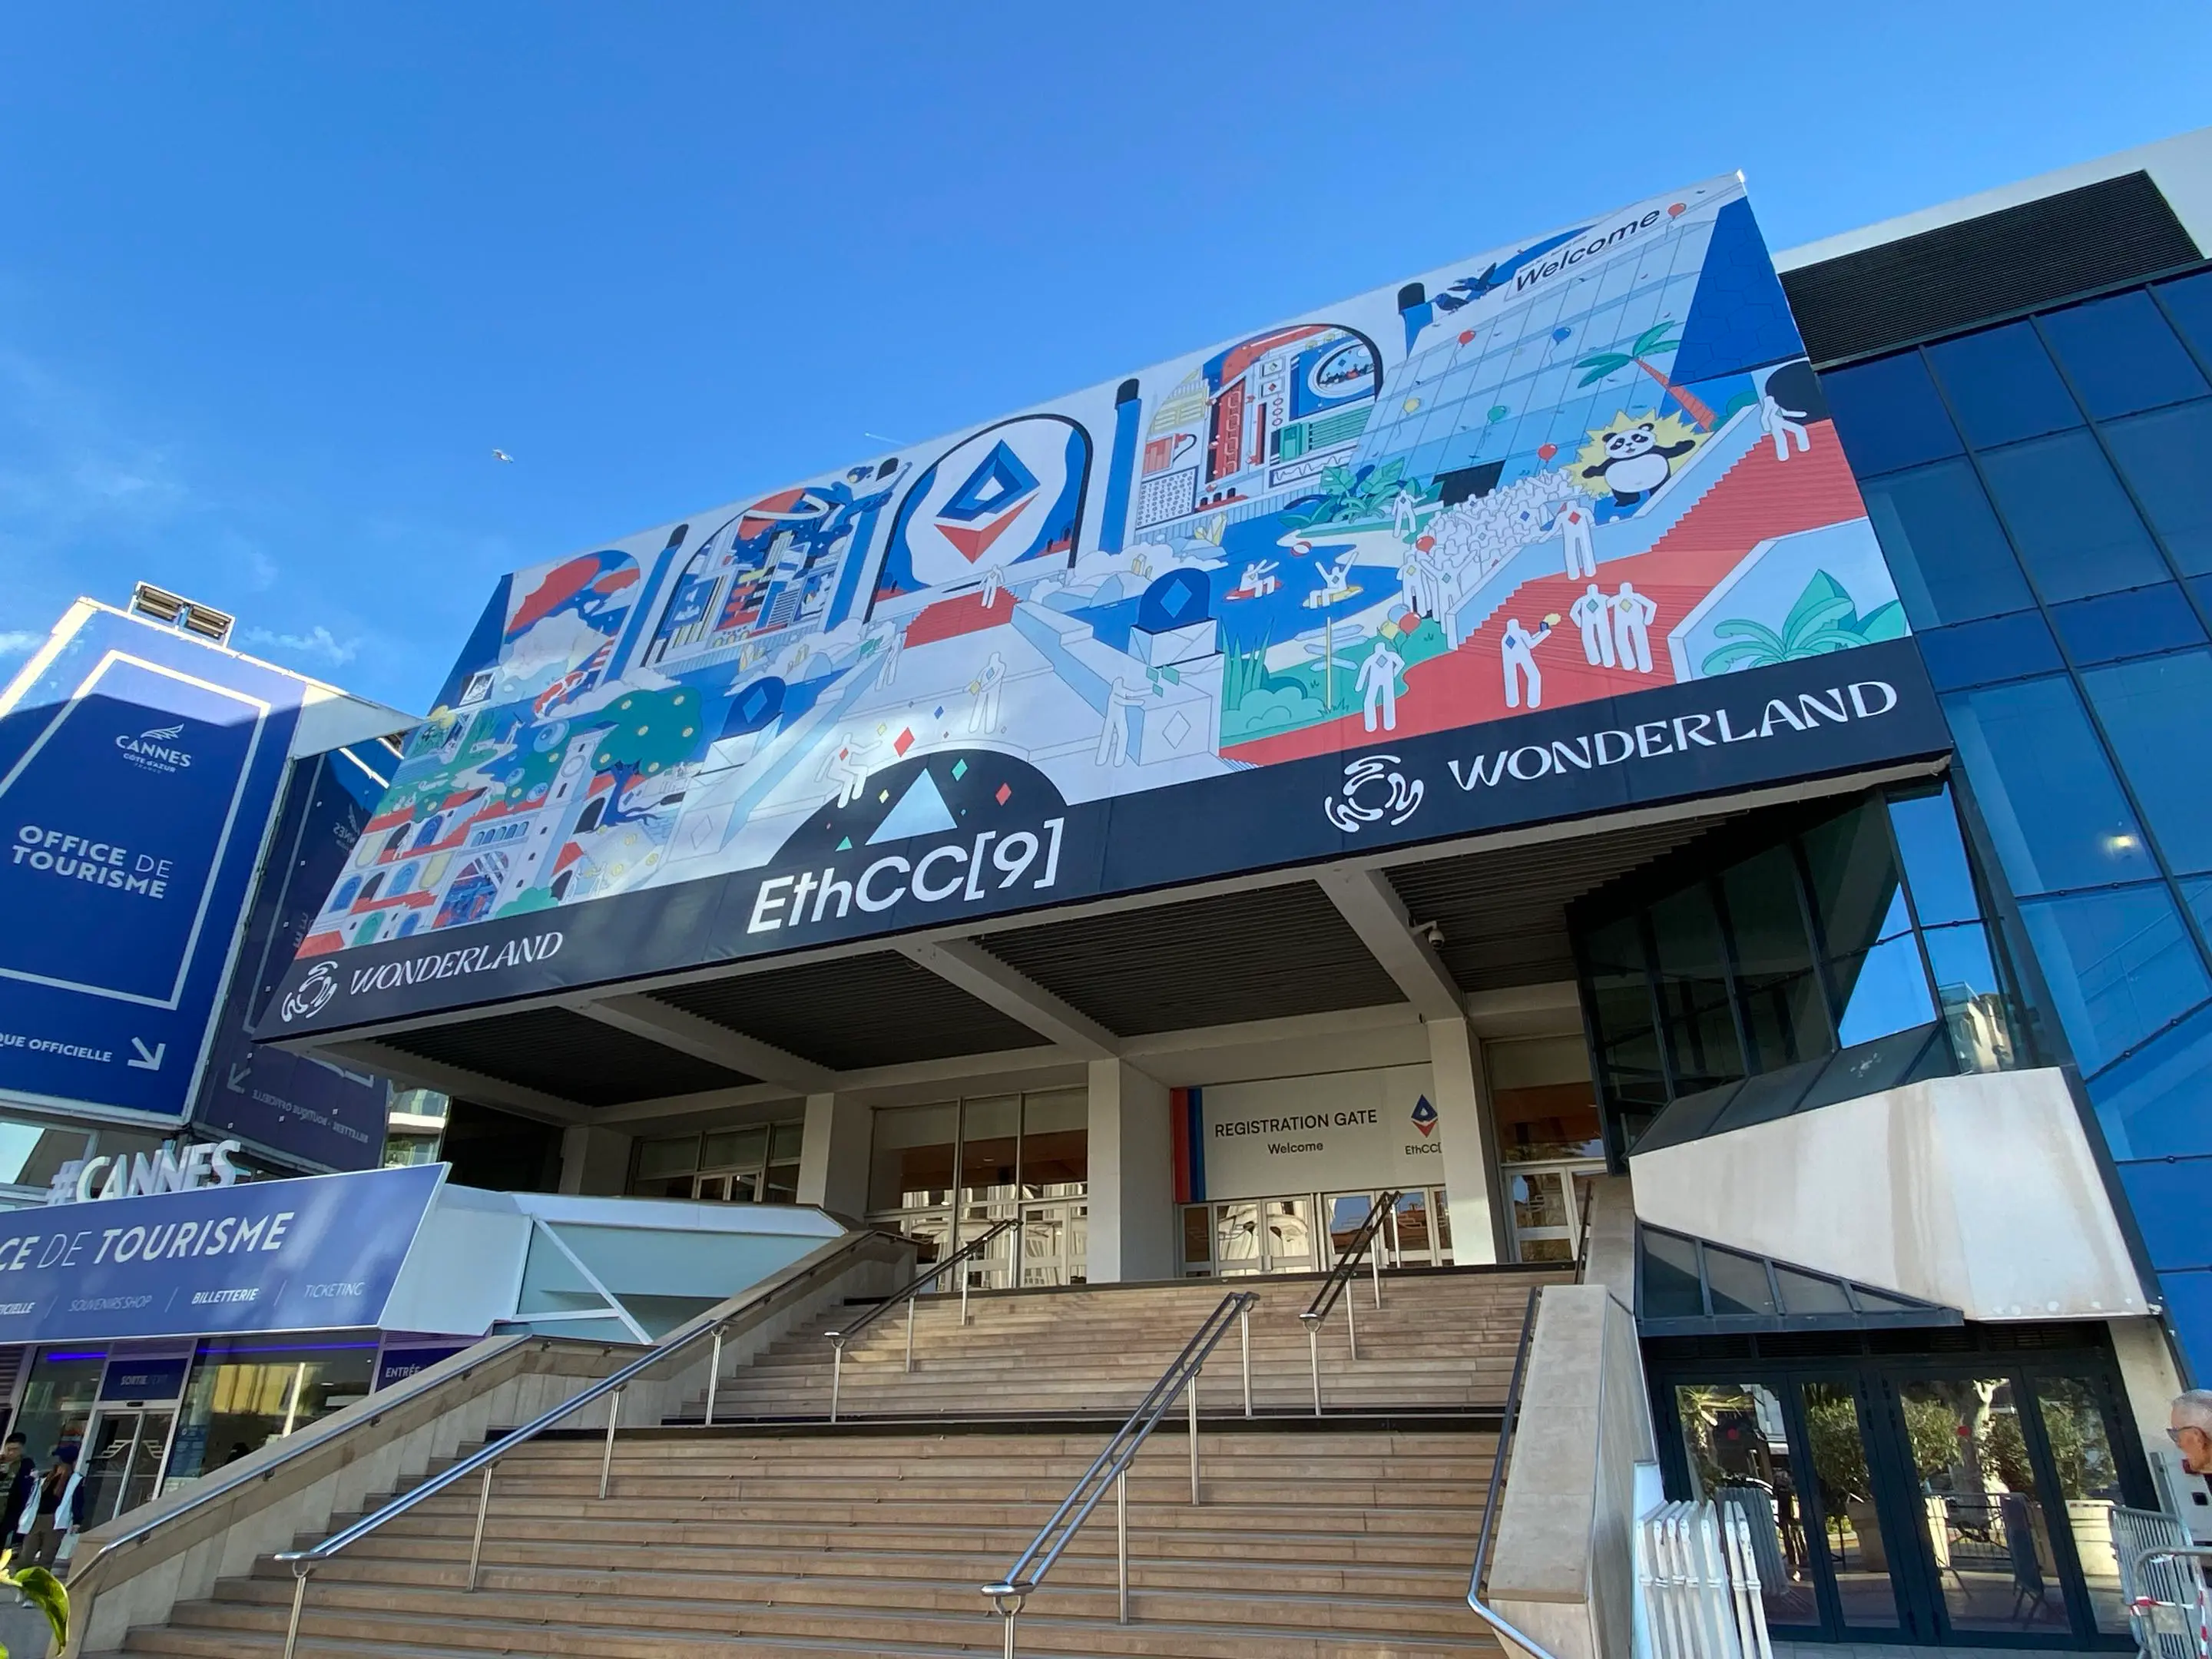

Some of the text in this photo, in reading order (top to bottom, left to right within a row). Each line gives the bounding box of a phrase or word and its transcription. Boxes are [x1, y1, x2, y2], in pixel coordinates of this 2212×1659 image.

[1517, 210, 1660, 292] Welcome
[116, 735, 191, 767] CANNES
[1448, 681, 1897, 791] WONDERLAND
[12, 845, 167, 899] TOURISME
[19, 826, 173, 878] OFFICE DE
[747, 817, 1065, 934] EthCC[9]
[350, 932, 563, 995] WONDERLAND
[29, 1038, 112, 1062] OFFICIELLE
[1215, 1109, 1377, 1137] REGISTRATION GATE
[1267, 1141, 1323, 1154] Welcome
[38, 1231, 91, 1268] DE
[93, 1212, 294, 1264] TOURISME
[192, 1288, 259, 1304] BILLETTERIE
[304, 1282, 365, 1297] TICKETING
